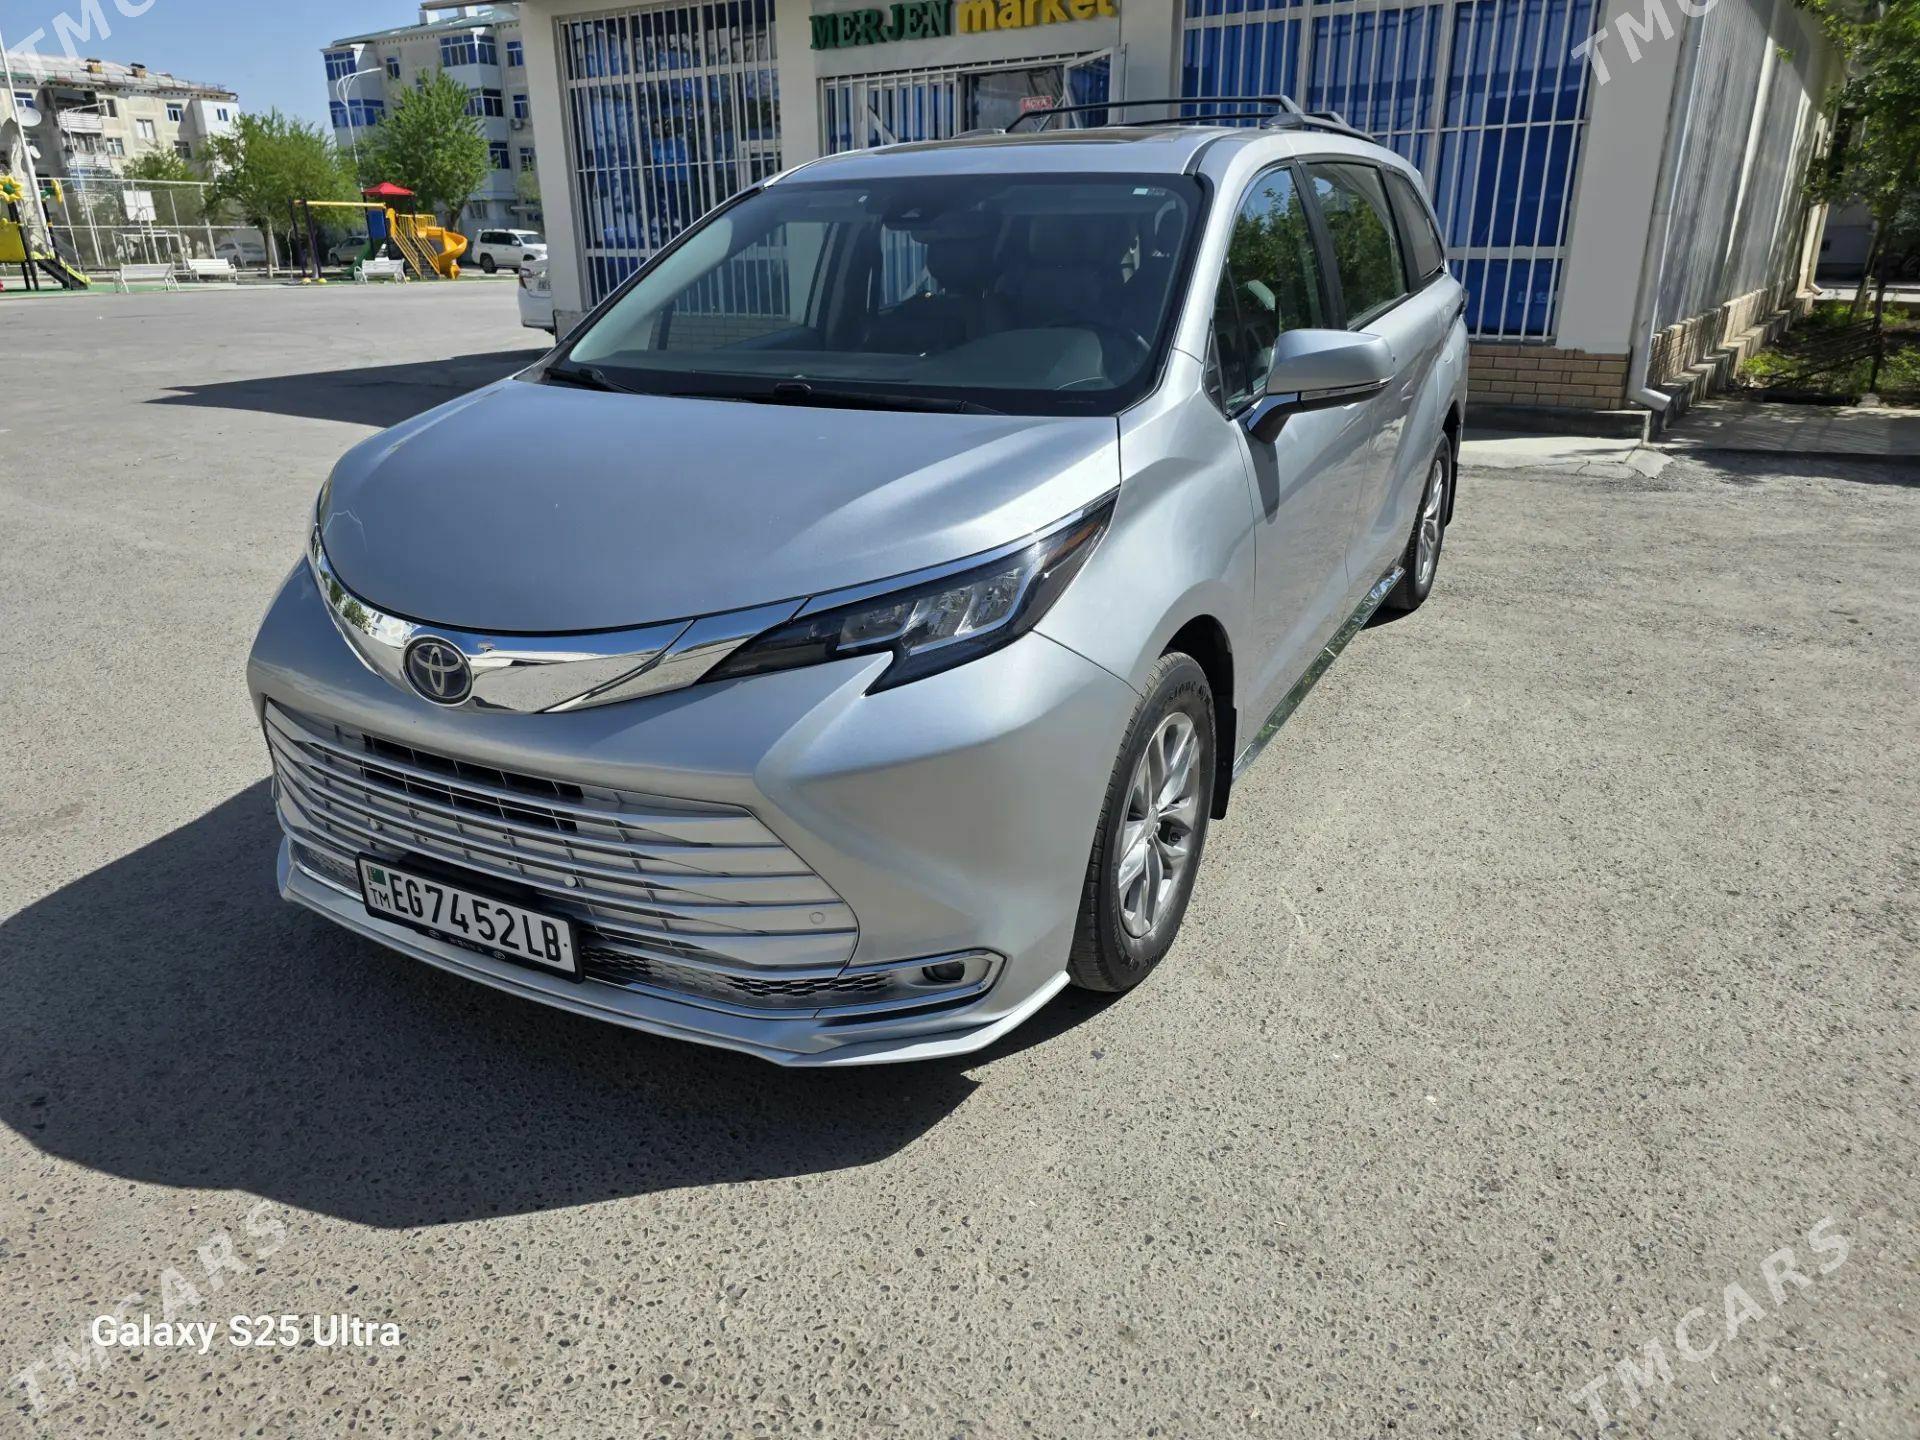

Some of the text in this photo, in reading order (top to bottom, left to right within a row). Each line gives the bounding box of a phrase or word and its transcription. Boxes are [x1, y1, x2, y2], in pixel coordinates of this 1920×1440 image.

[809, 0, 951, 50] MERJEN
[369, 872, 562, 963] TM EG7452LB
